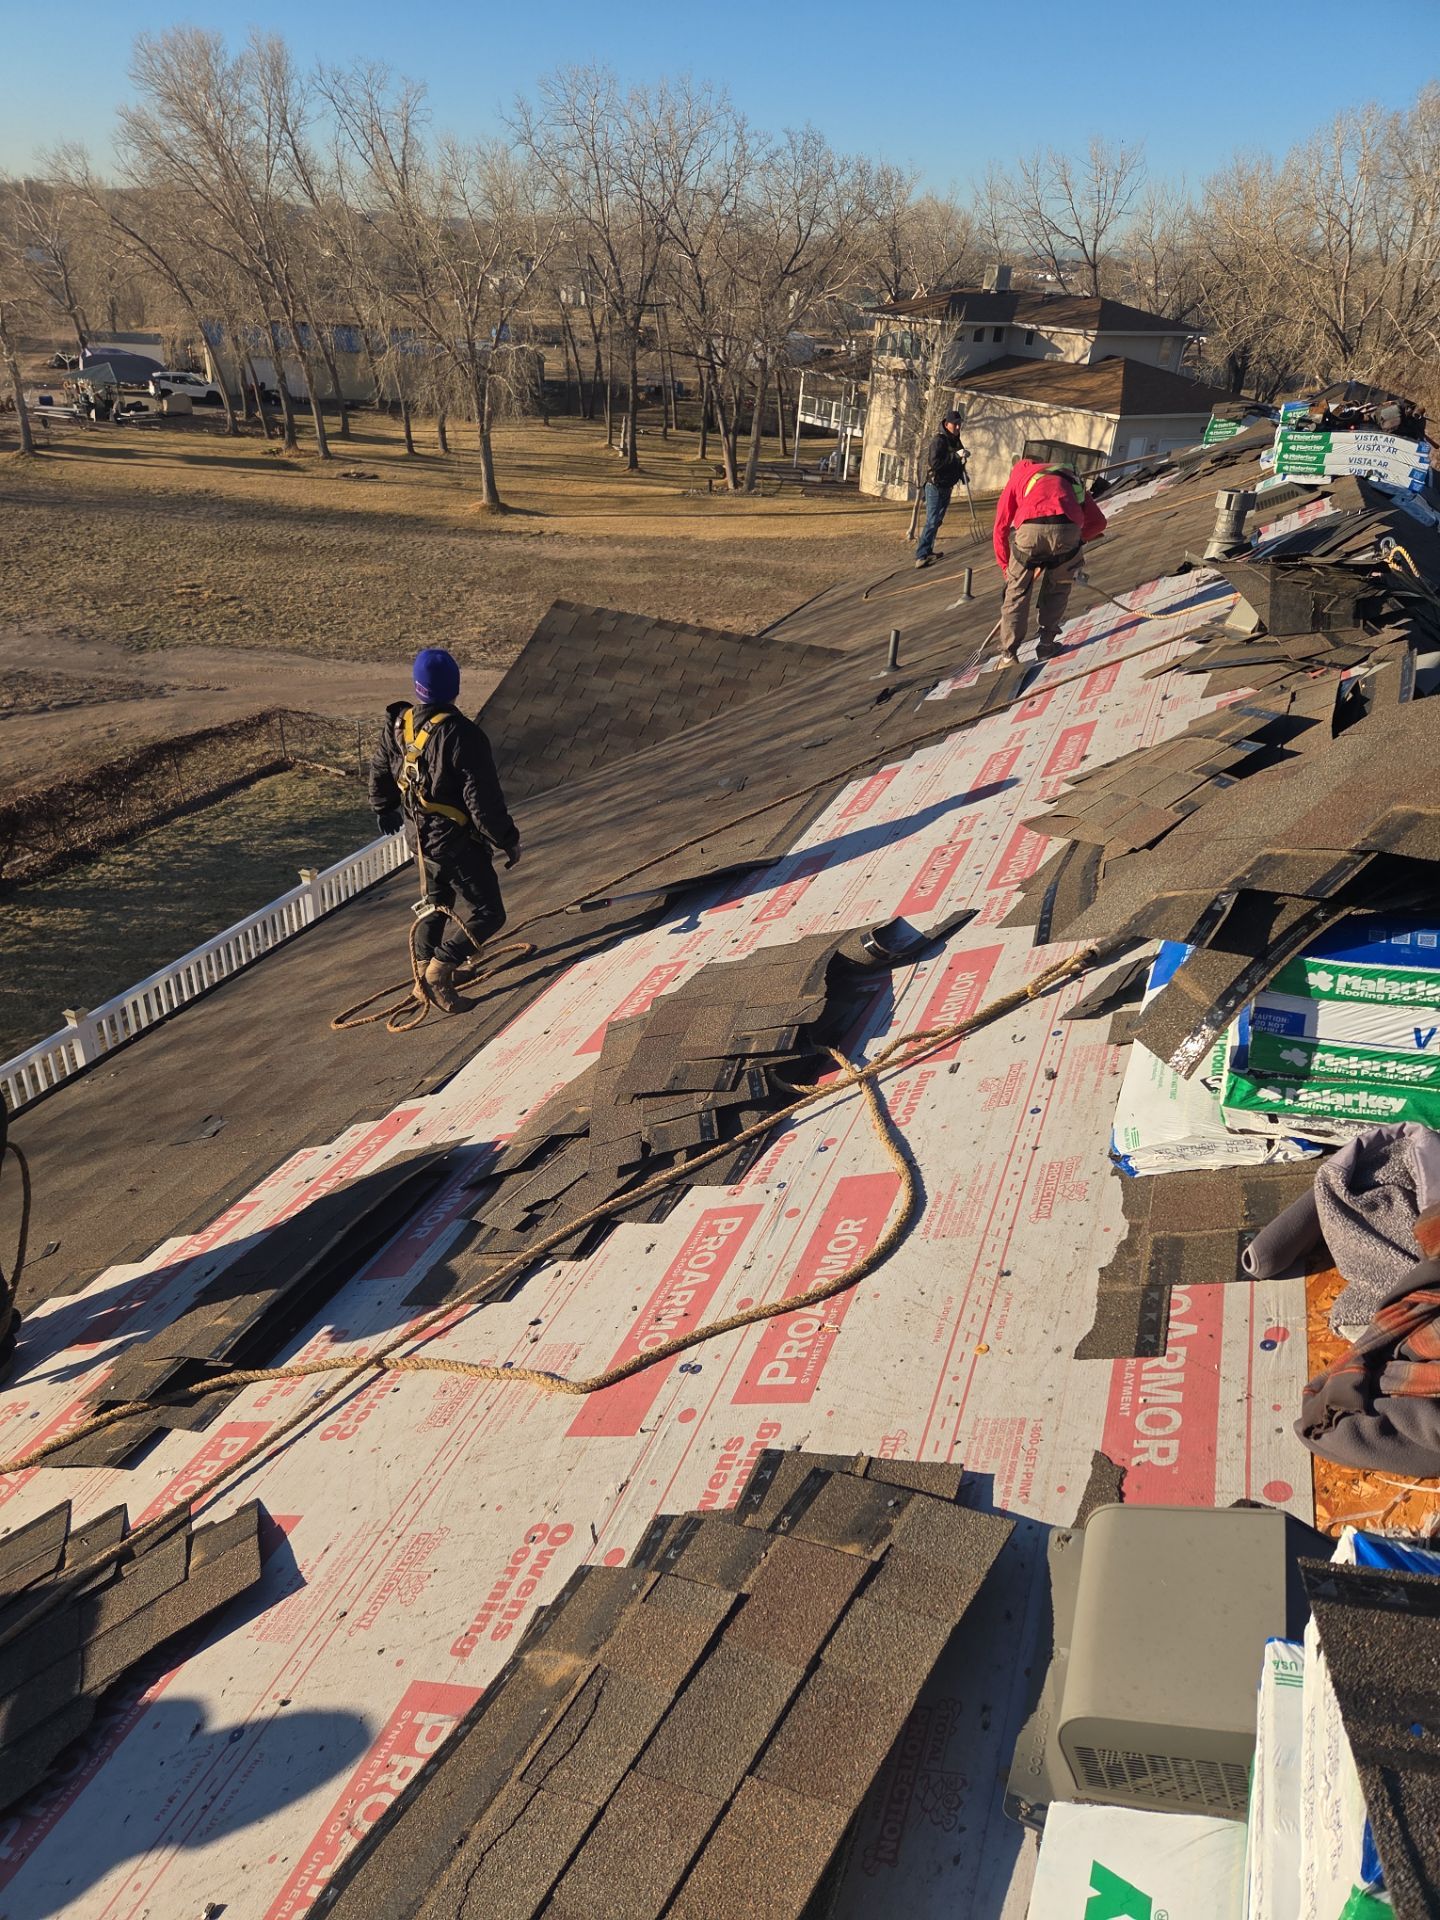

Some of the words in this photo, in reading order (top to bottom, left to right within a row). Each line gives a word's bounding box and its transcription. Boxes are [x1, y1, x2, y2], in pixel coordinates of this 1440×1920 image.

[1378, 459, 1389, 468] AR
[1384, 436, 1396, 445] AR
[1386, 446, 1398, 455] AR
[1335, 987, 1385, 1001] Roofing
[1267, 1021, 1286, 1030] NOT
[1310, 1064, 1358, 1077] Roofing
[1312, 1052, 1438, 1079] Malarkey
[895, 1069, 937, 1128] Corning
[1284, 1099, 1331, 1112] Roofing
[1334, 1104, 1389, 1117] Products
[1285, 1086, 1408, 1113] Malarkey
[754, 1132, 798, 1185] Owens
[1038, 1162, 1063, 1219] PROTECTION
[637, 1216, 745, 1353] PROARMO
[801, 1333, 828, 1384] SYNTHETIC
[697, 1435, 745, 1512] wens
[361, 1534, 431, 1627] PROTECTION
[450, 1522, 550, 1658] Corning
[490, 1523, 575, 1642] Owens
[1271, 1659, 1297, 1671] USA
[356, 1710, 411, 1793] SYNTHETIC
[324, 1798, 356, 1845] ROOF
